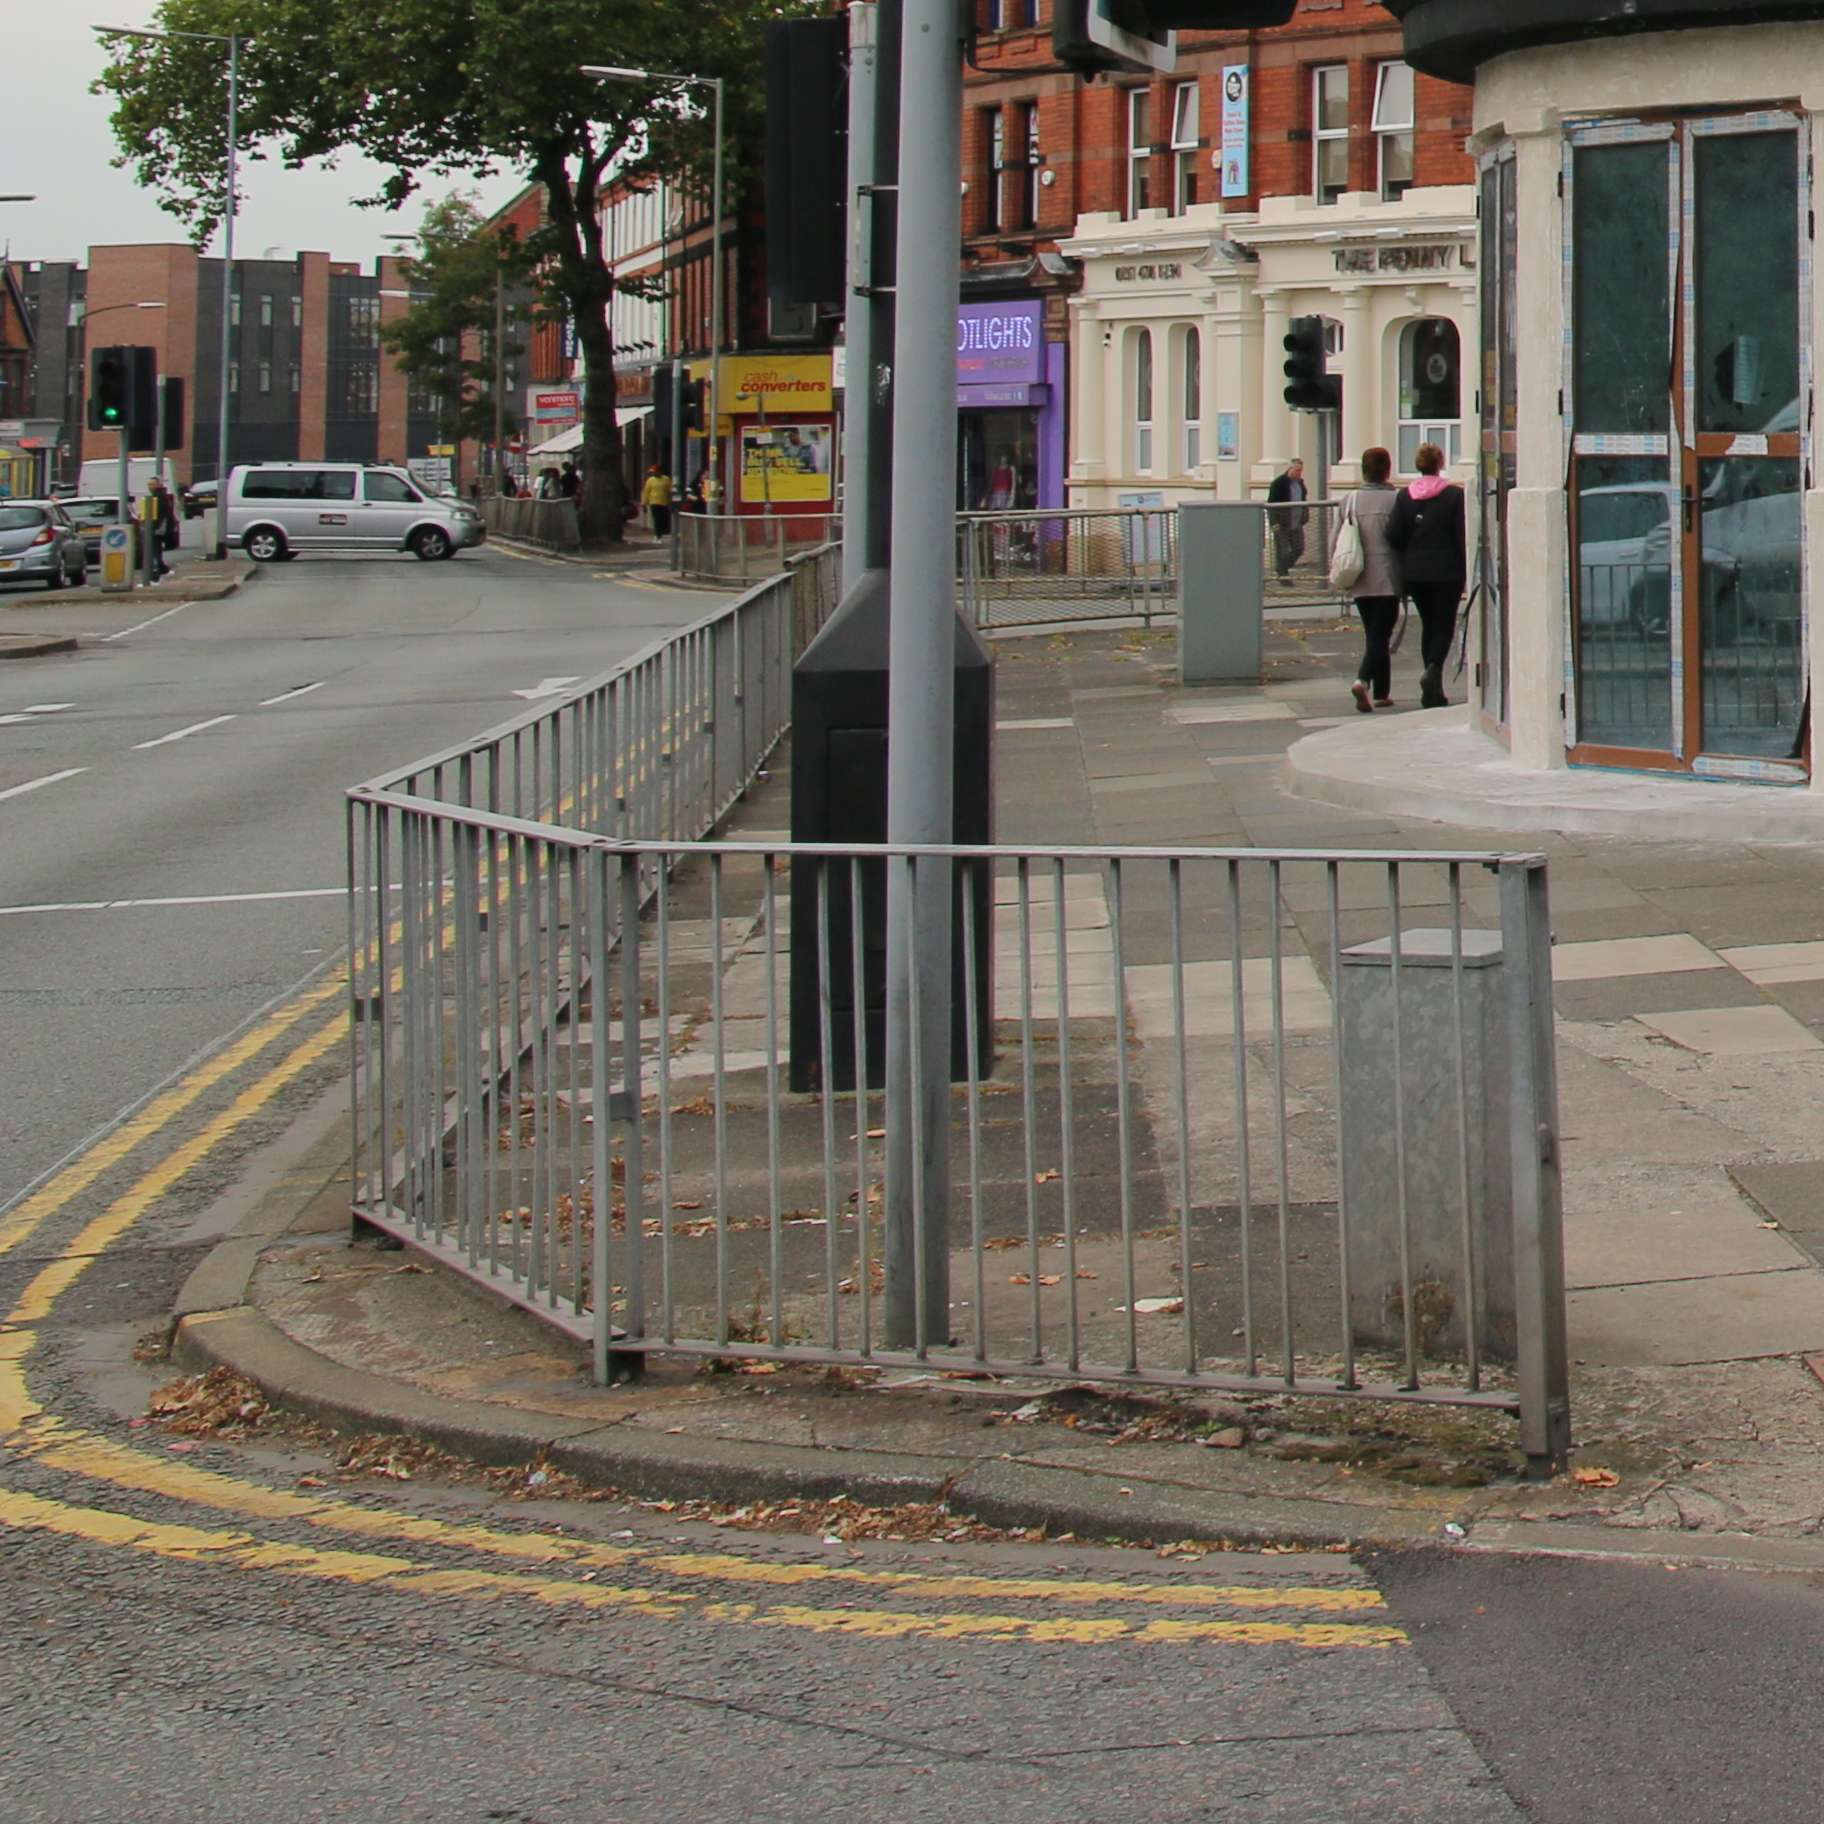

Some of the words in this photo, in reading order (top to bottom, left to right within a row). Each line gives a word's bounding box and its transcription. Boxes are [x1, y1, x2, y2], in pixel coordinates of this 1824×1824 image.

[1331, 248, 1376, 273] THE
[1378, 244, 1455, 271] PENNY
[743, 371, 778, 382] cash
[740, 379, 826, 393] converters
